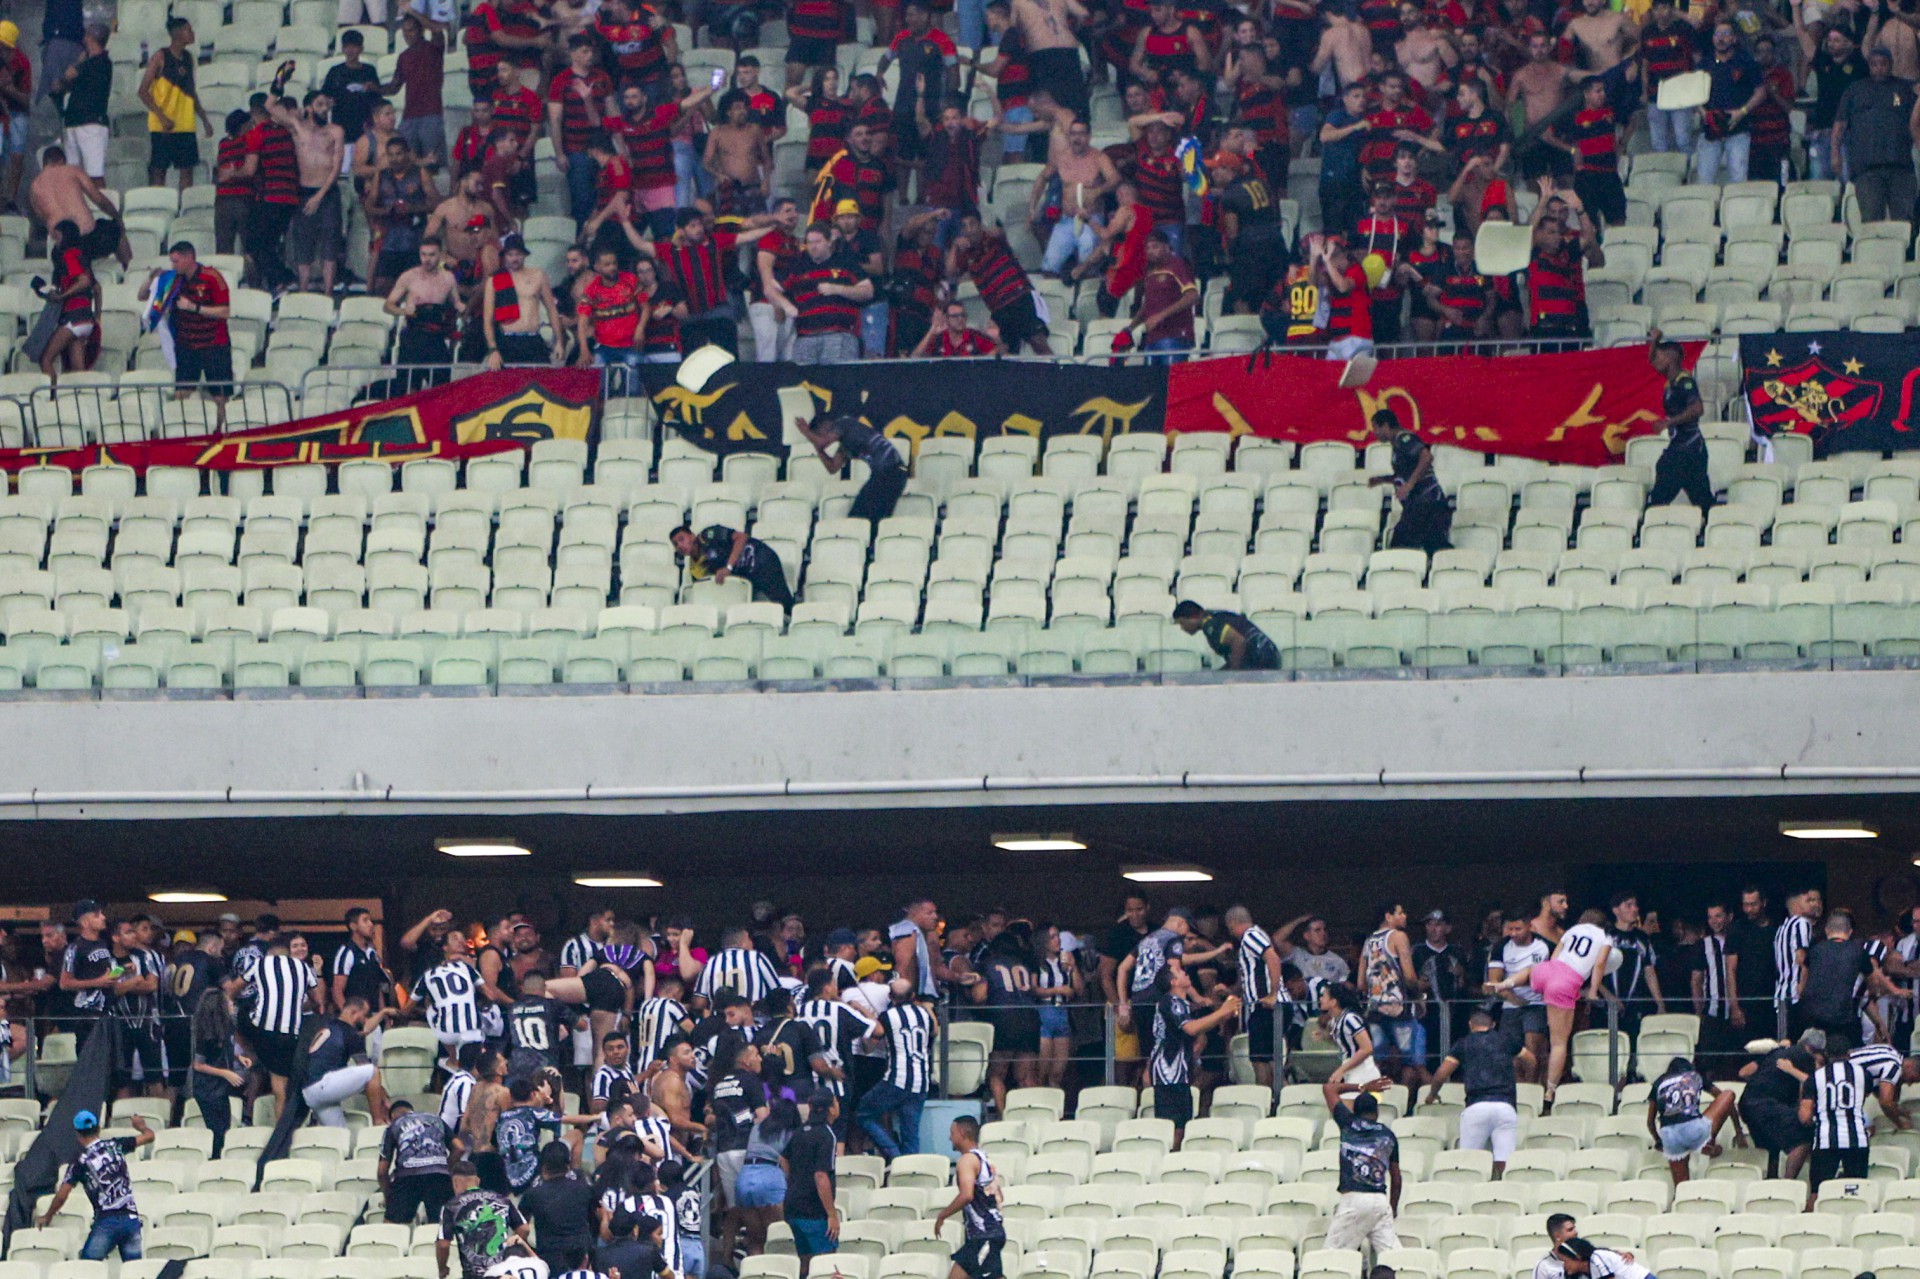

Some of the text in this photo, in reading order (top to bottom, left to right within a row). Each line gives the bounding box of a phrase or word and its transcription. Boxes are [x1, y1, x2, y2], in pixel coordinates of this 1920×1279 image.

[1291, 285, 1319, 315] 90
[1568, 935, 1593, 958] 10
[430, 972, 469, 999] 10
[995, 964, 1030, 992] 10
[514, 1017, 549, 1050] 10
[899, 1025, 928, 1060] 10
[1826, 1080, 1855, 1110] 10
